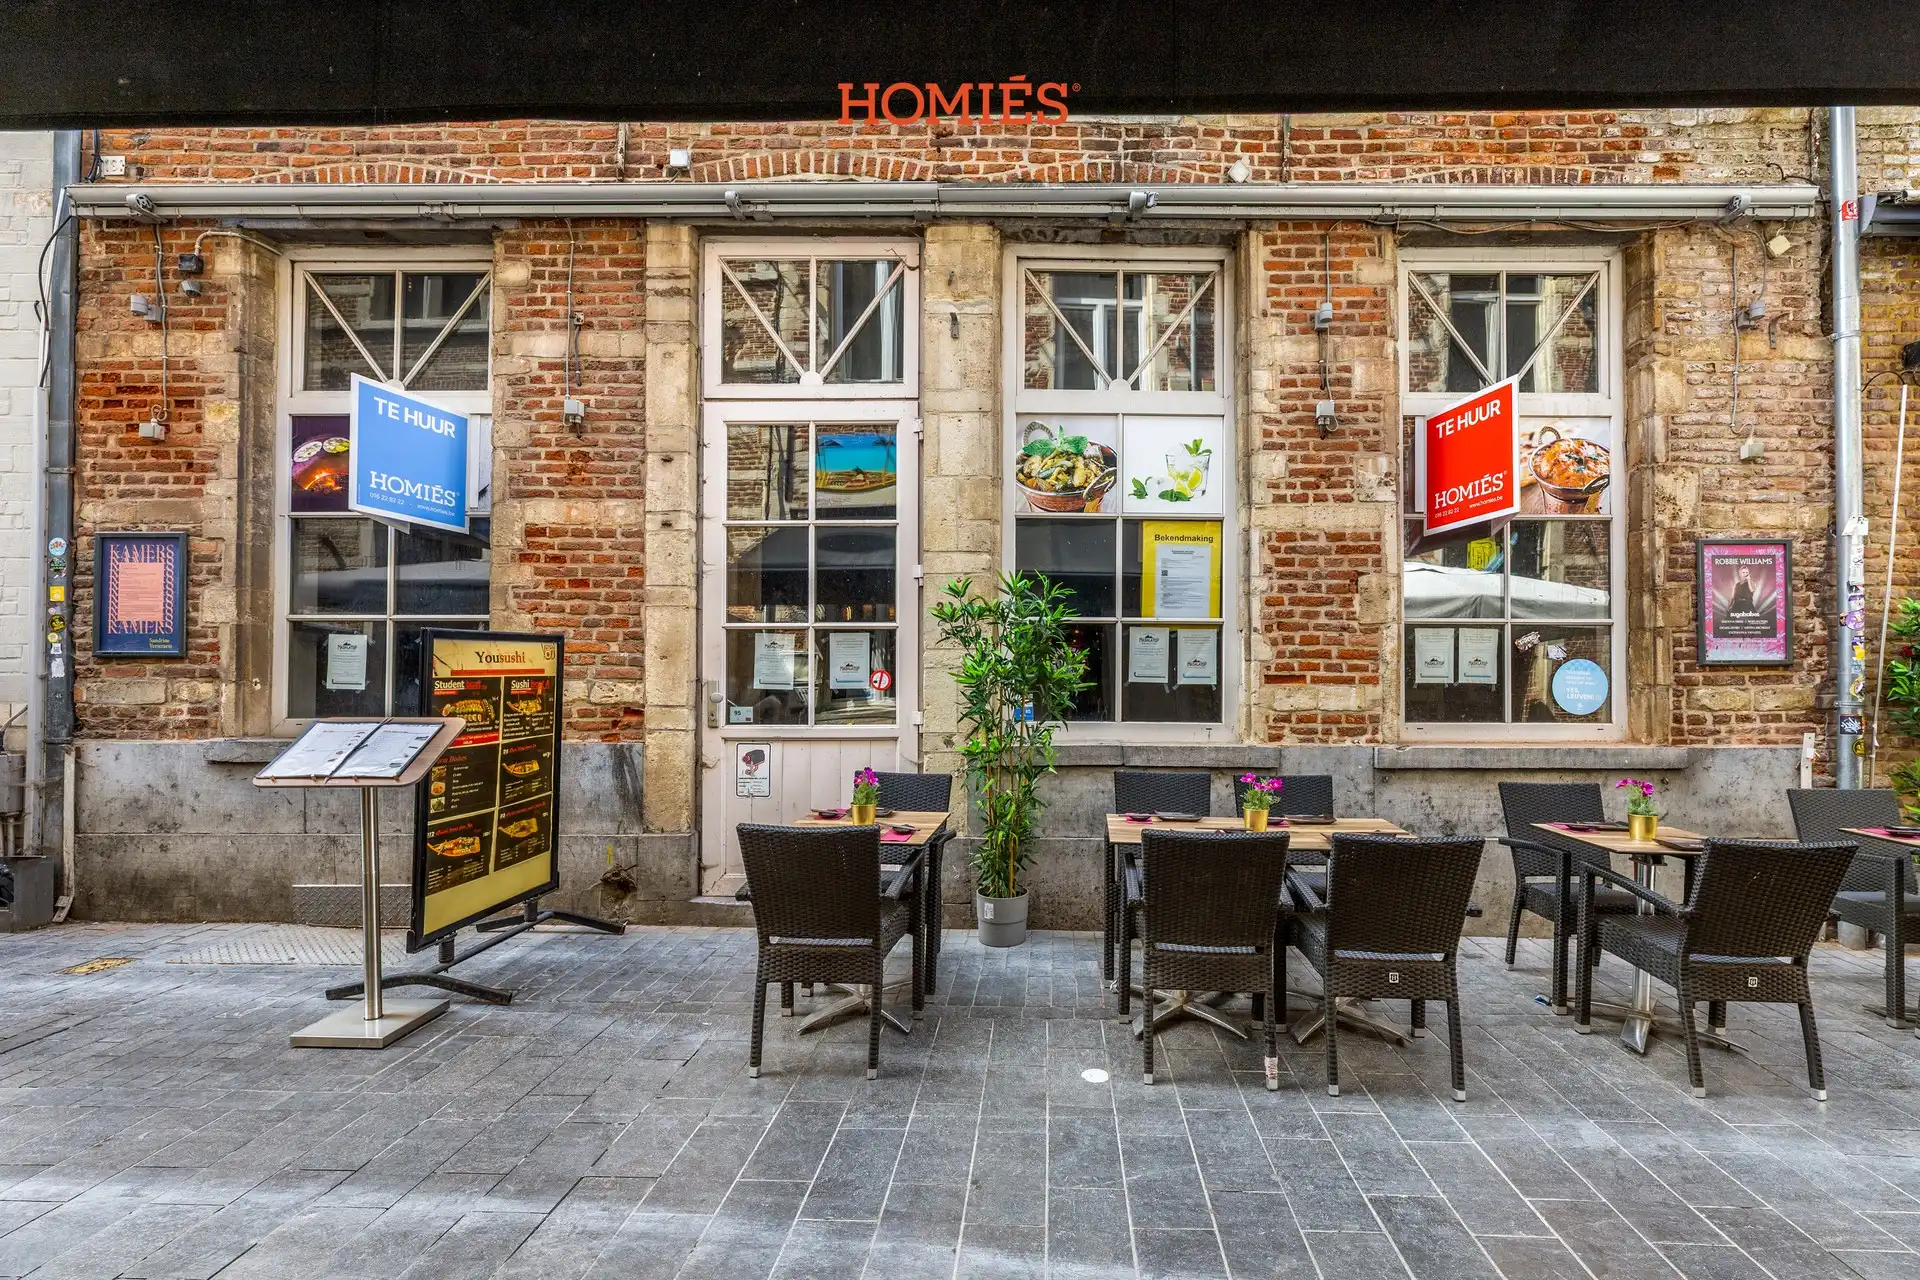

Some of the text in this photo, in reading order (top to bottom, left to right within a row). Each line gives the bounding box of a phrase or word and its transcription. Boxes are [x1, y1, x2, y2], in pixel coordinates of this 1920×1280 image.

[373, 396, 456, 438] TE HUUR
[1435, 399, 1501, 439] TE HUUR
[1154, 533, 1214, 544] Bekendmaking
[1714, 557, 1773, 566] ROBBIE WILLIAMS
[474, 650, 526, 664] Yousushi
[434, 680, 465, 689] Student
[511, 679, 530, 689] Sushi
